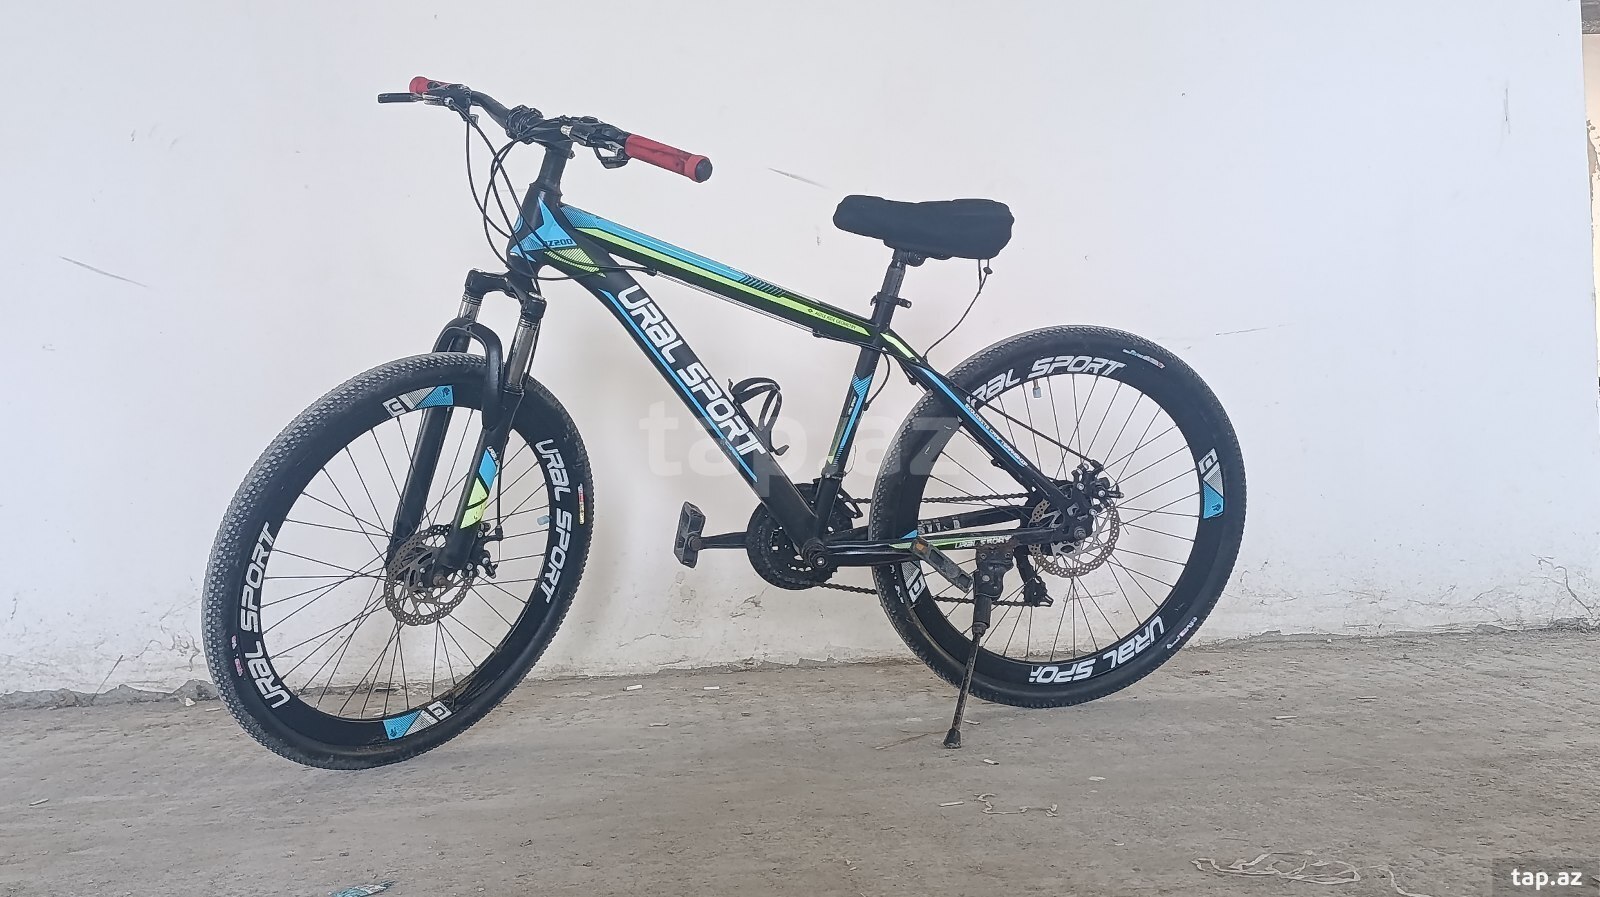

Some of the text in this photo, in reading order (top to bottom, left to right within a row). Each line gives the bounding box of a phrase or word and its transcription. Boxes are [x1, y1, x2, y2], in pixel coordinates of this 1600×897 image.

[676, 362, 767, 456] SPORT
[1028, 355, 1127, 378] SPORT
[240, 521, 275, 633] SPORT
[540, 508, 573, 603] SPORT
